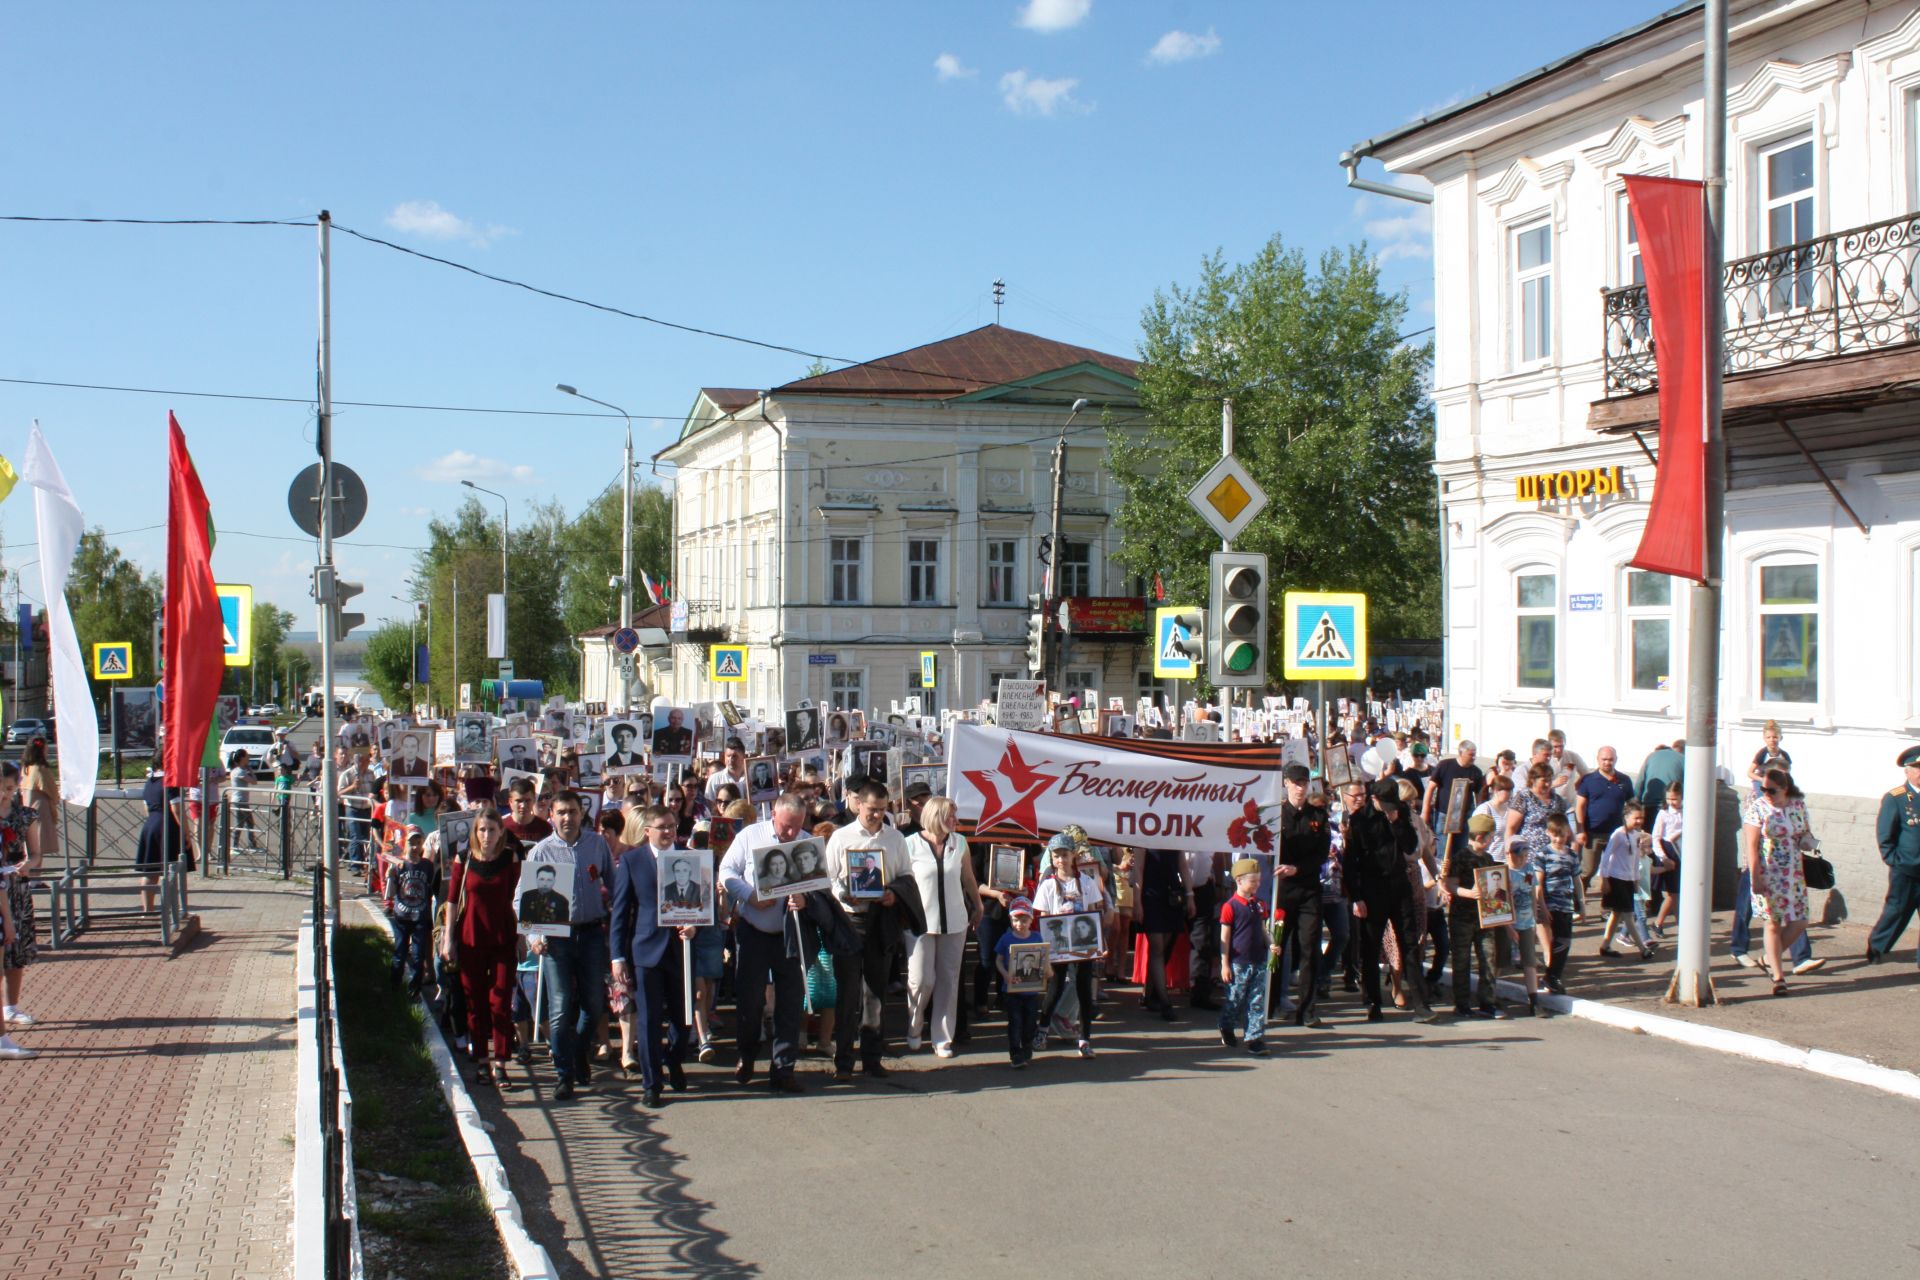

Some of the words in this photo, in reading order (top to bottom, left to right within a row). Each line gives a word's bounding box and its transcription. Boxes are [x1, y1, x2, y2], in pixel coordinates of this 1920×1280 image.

[1515, 465, 1622, 502] ШТОРЫ
[1058, 760, 1262, 807] Бессмертный
[1115, 811, 1204, 837] ПОЛК
